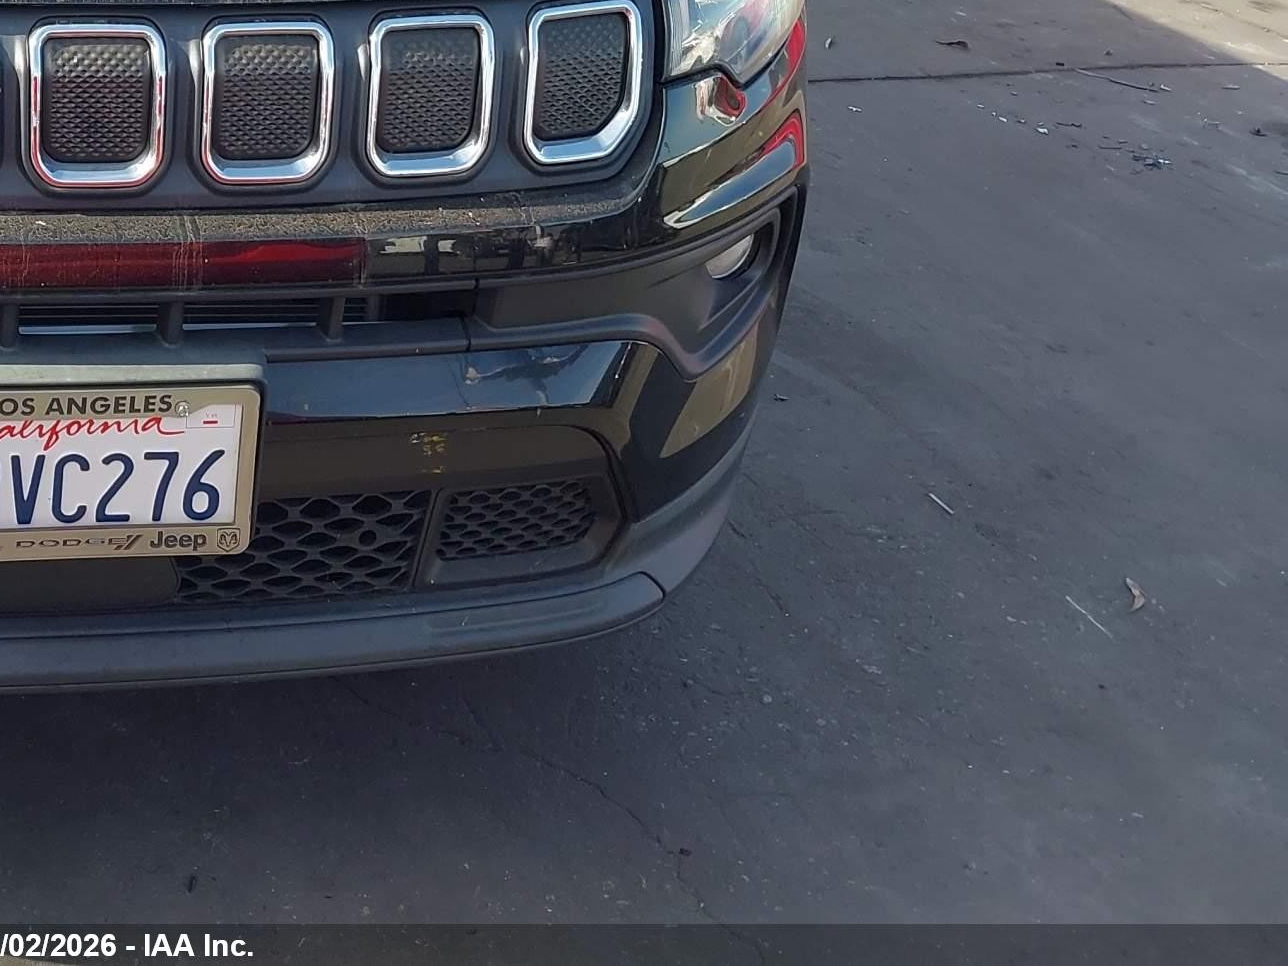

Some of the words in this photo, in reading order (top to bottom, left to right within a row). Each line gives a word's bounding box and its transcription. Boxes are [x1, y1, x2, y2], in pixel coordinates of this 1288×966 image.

[45, 395, 172, 416] ANGELES
[16, 537, 130, 548] DODGE
[150, 531, 208, 551] Jeep
